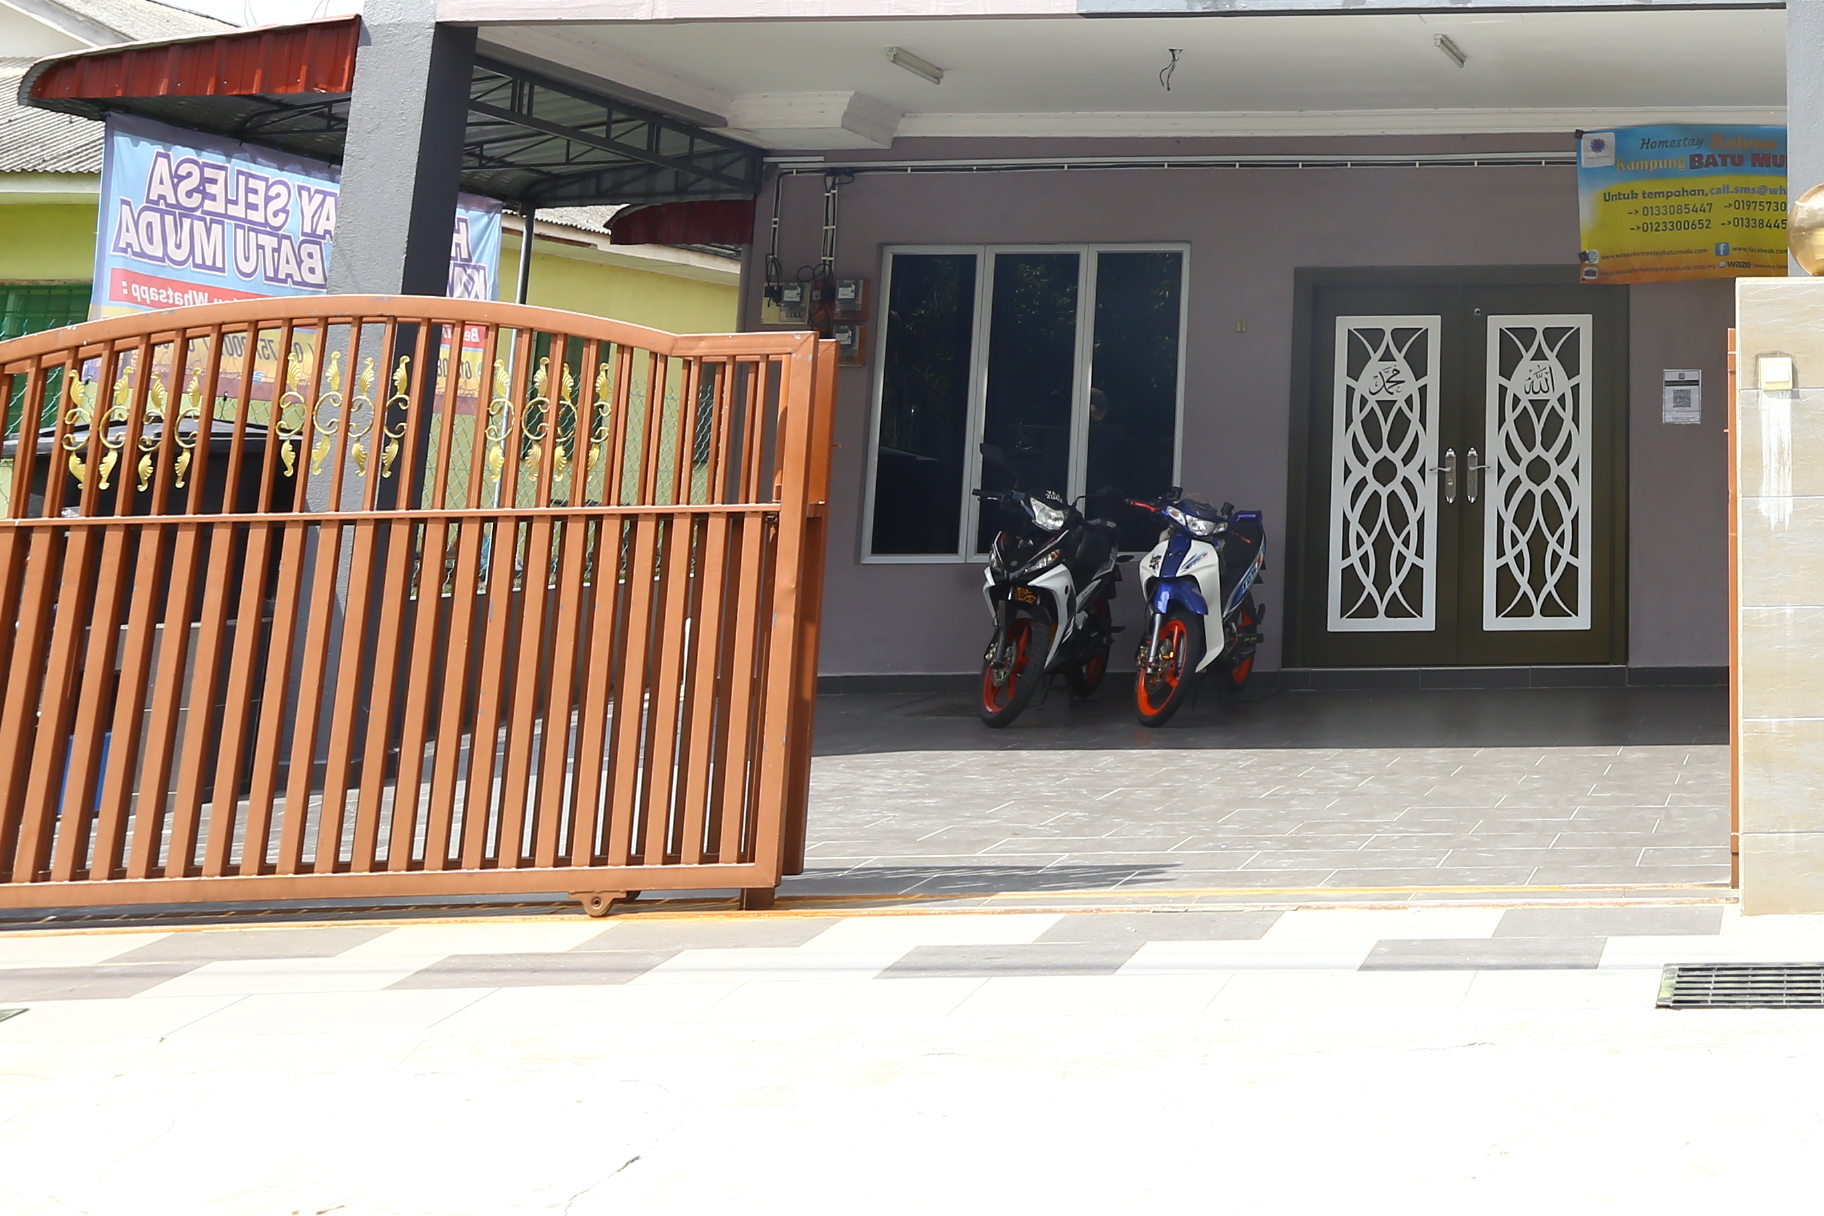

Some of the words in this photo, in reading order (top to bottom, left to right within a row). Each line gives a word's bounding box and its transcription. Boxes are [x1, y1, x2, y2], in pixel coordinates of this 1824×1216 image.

[1640, 136, 1704, 151] Homestay
[1710, 133, 1777, 150] Selesa
[1615, 155, 1687, 172] Kampung
[1689, 153, 1744, 170] BATU
[1603, 189, 1639, 203] Untuk
[1641, 186, 1709, 200] tempahan,
[1641, 202, 1713, 217] 0133085447
[1641, 218, 1712, 233] 0123300652
[1727, 260, 1752, 269] waze
